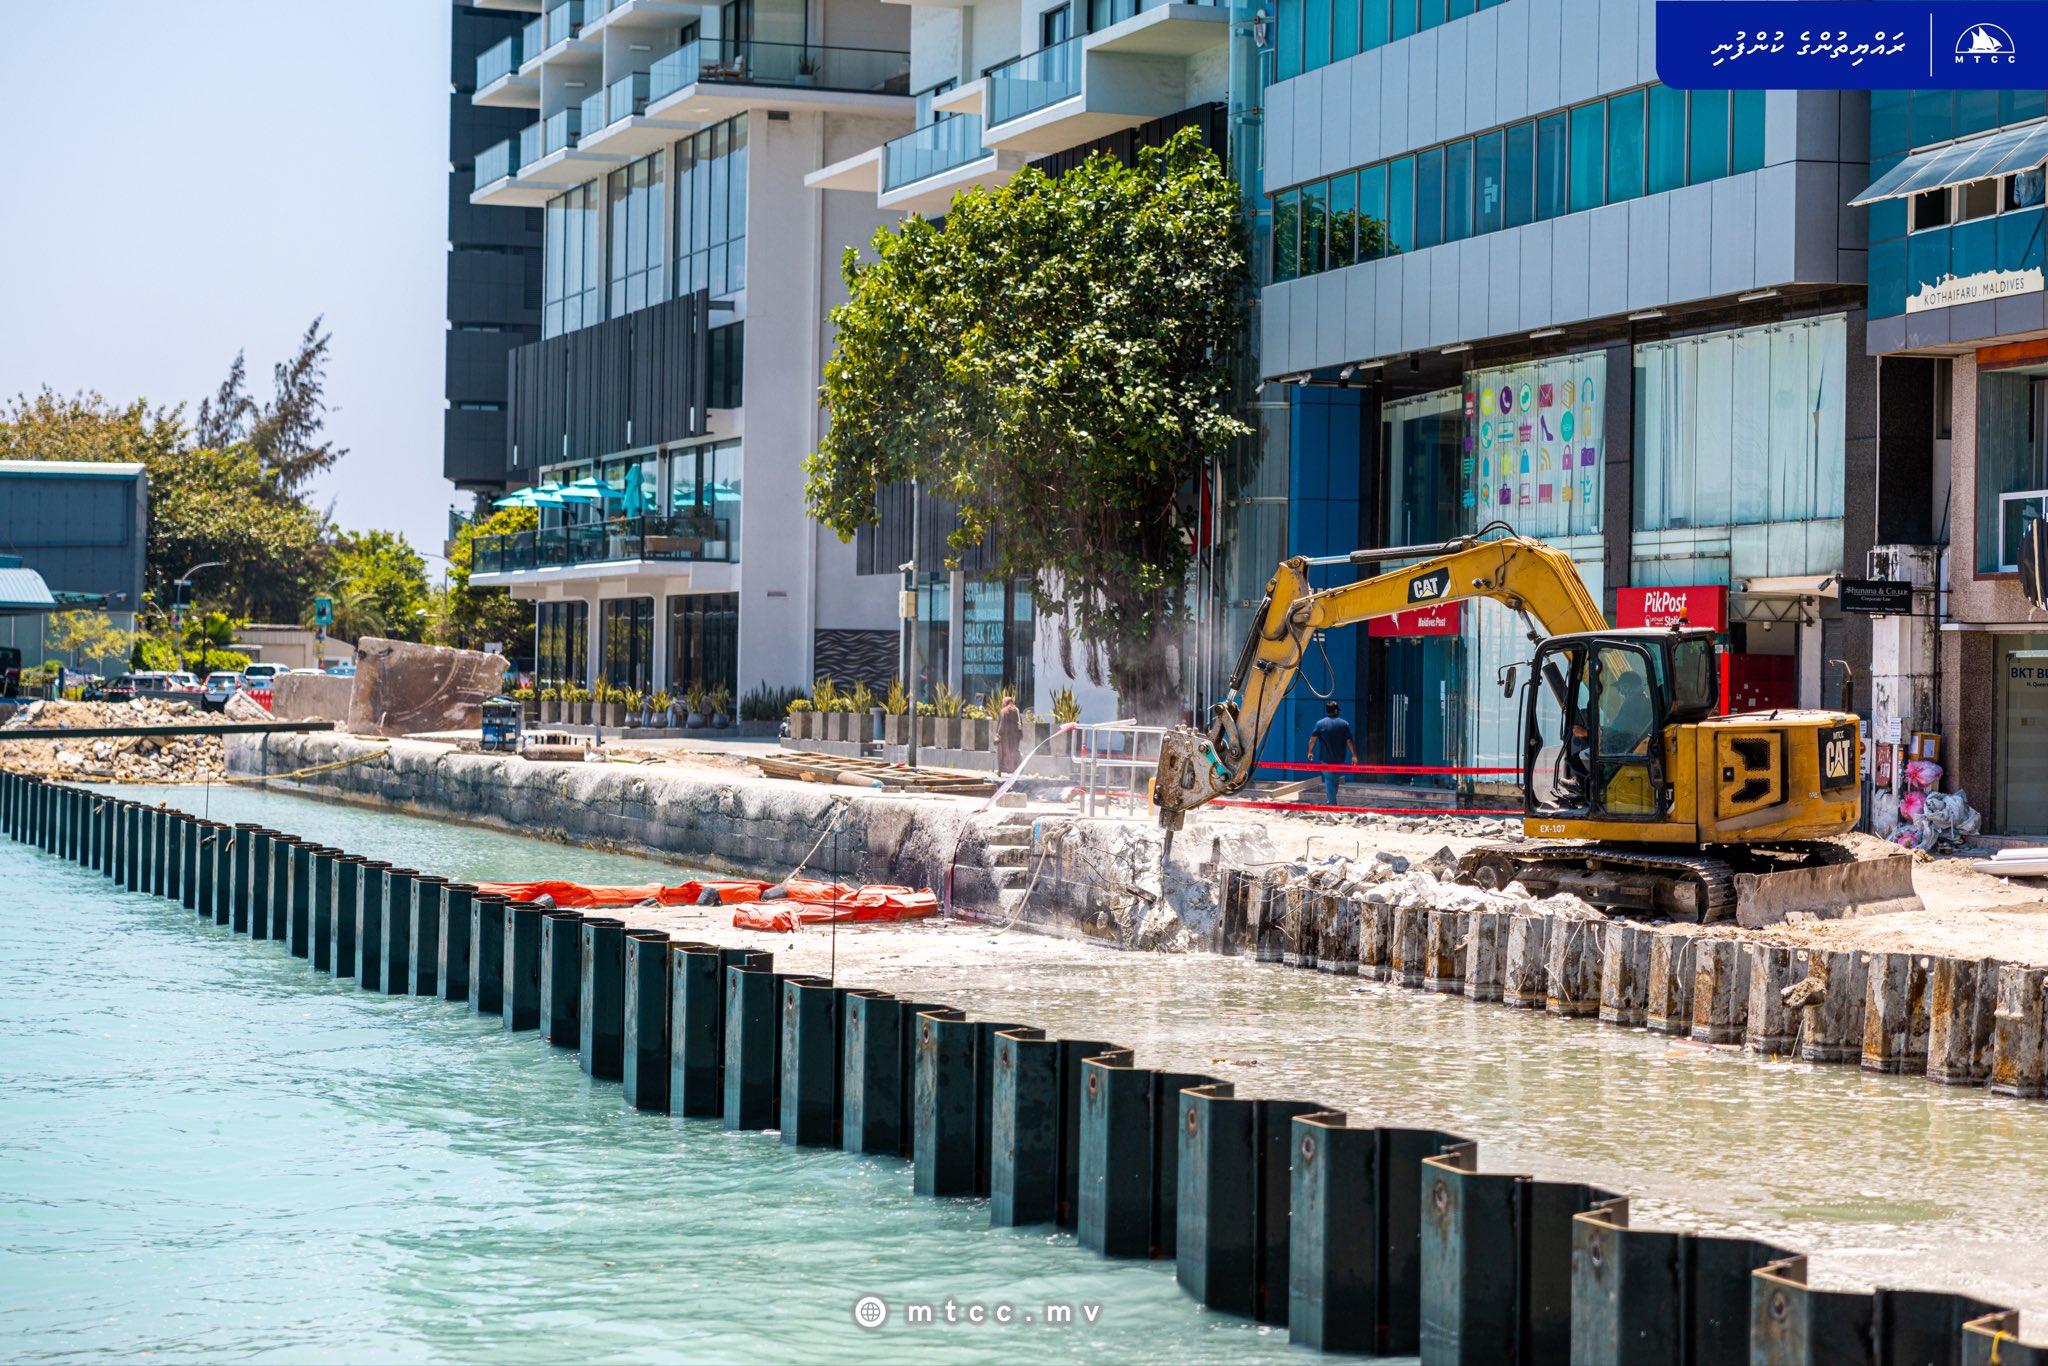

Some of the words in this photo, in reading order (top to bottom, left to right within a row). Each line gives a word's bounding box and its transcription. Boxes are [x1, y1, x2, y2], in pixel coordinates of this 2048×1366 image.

[1983, 277, 2024, 297] MALDIVES
[1413, 577, 1439, 599] CAT
[1644, 591, 1687, 612] PikPost
[2011, 667, 2034, 679] BKT
[1826, 739, 1850, 778] CAT
[1540, 824, 1566, 833] EX-107
